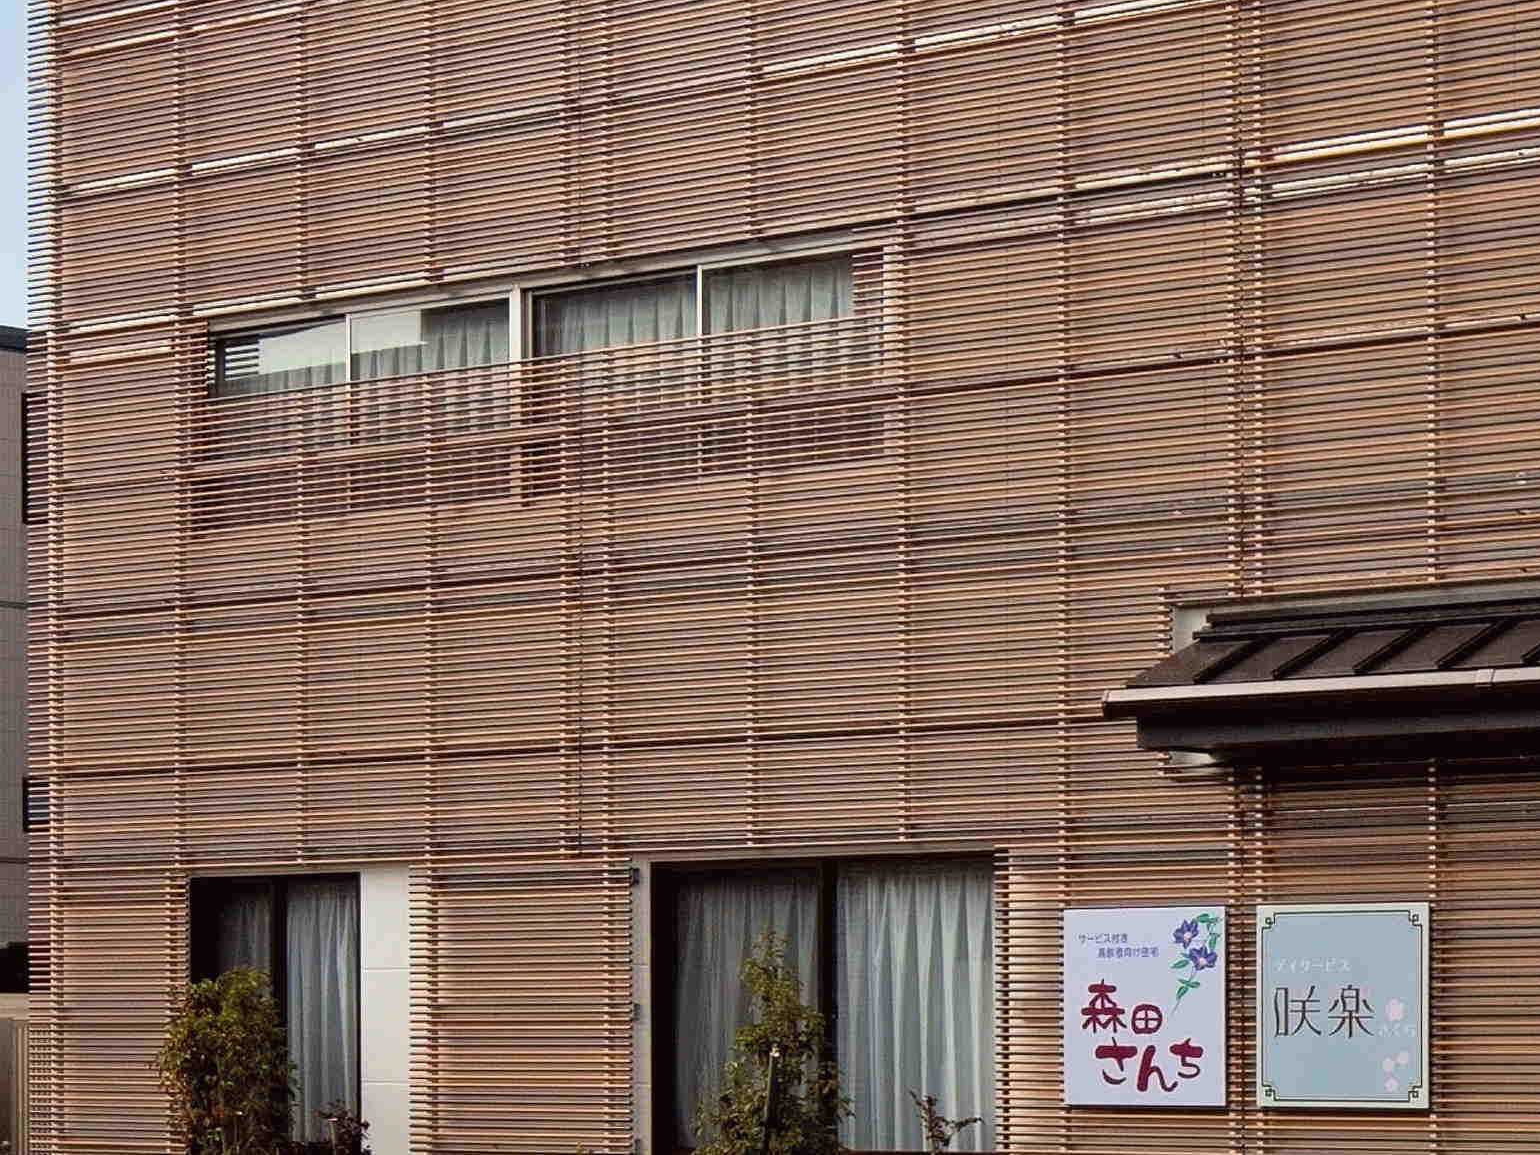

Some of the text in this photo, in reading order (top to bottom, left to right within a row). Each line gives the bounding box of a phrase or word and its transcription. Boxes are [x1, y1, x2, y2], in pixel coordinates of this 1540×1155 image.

[1081, 979, 1163, 1034] 森田
[1274, 984, 1375, 1039] 咲楽
[1095, 1037, 1204, 1092] さんち
